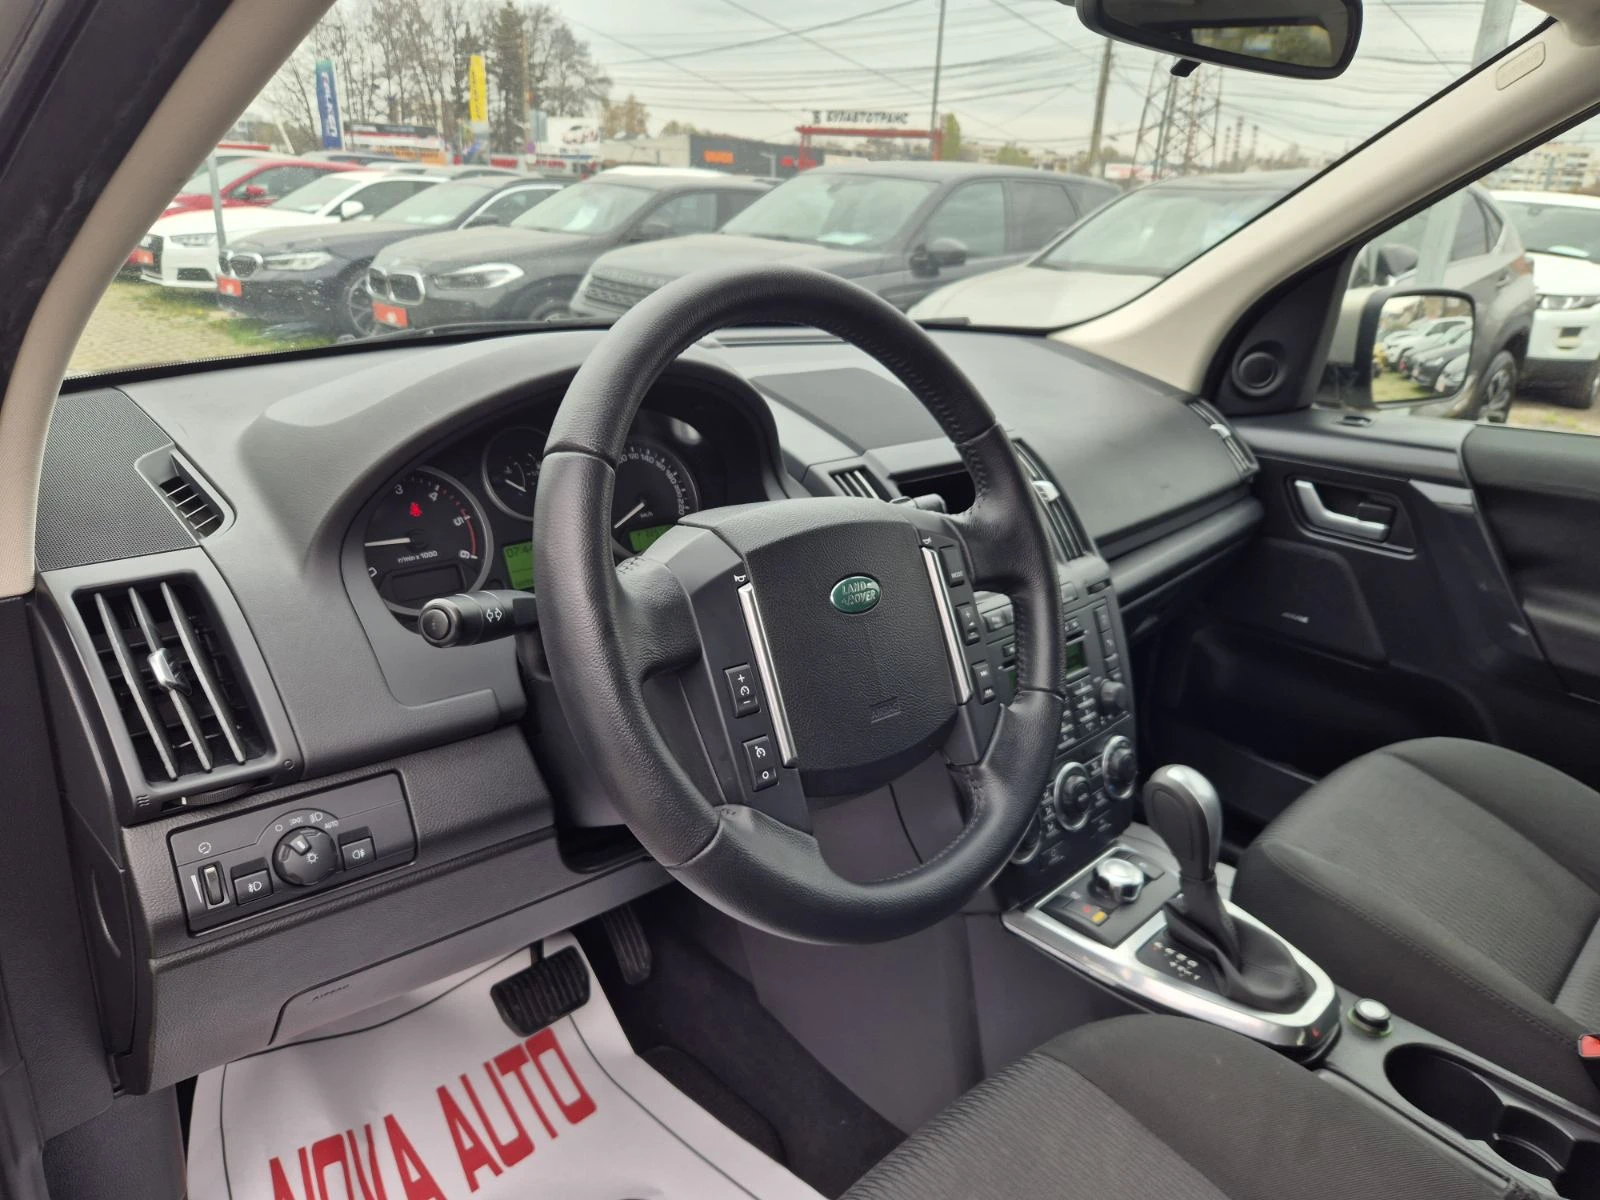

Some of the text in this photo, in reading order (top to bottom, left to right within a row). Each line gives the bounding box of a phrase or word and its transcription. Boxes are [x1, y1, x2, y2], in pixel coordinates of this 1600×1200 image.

[640, 453, 655, 464] 140
[394, 484, 404, 495] 3
[428, 491, 439, 502] 4
[453, 516, 464, 526] 5
[421, 550, 438, 559] 1000
[459, 549, 471, 560] 6
[841, 581, 867, 594] LAND
[847, 589, 876, 605] ROVER
[436, 1026, 597, 1193] AUTO
